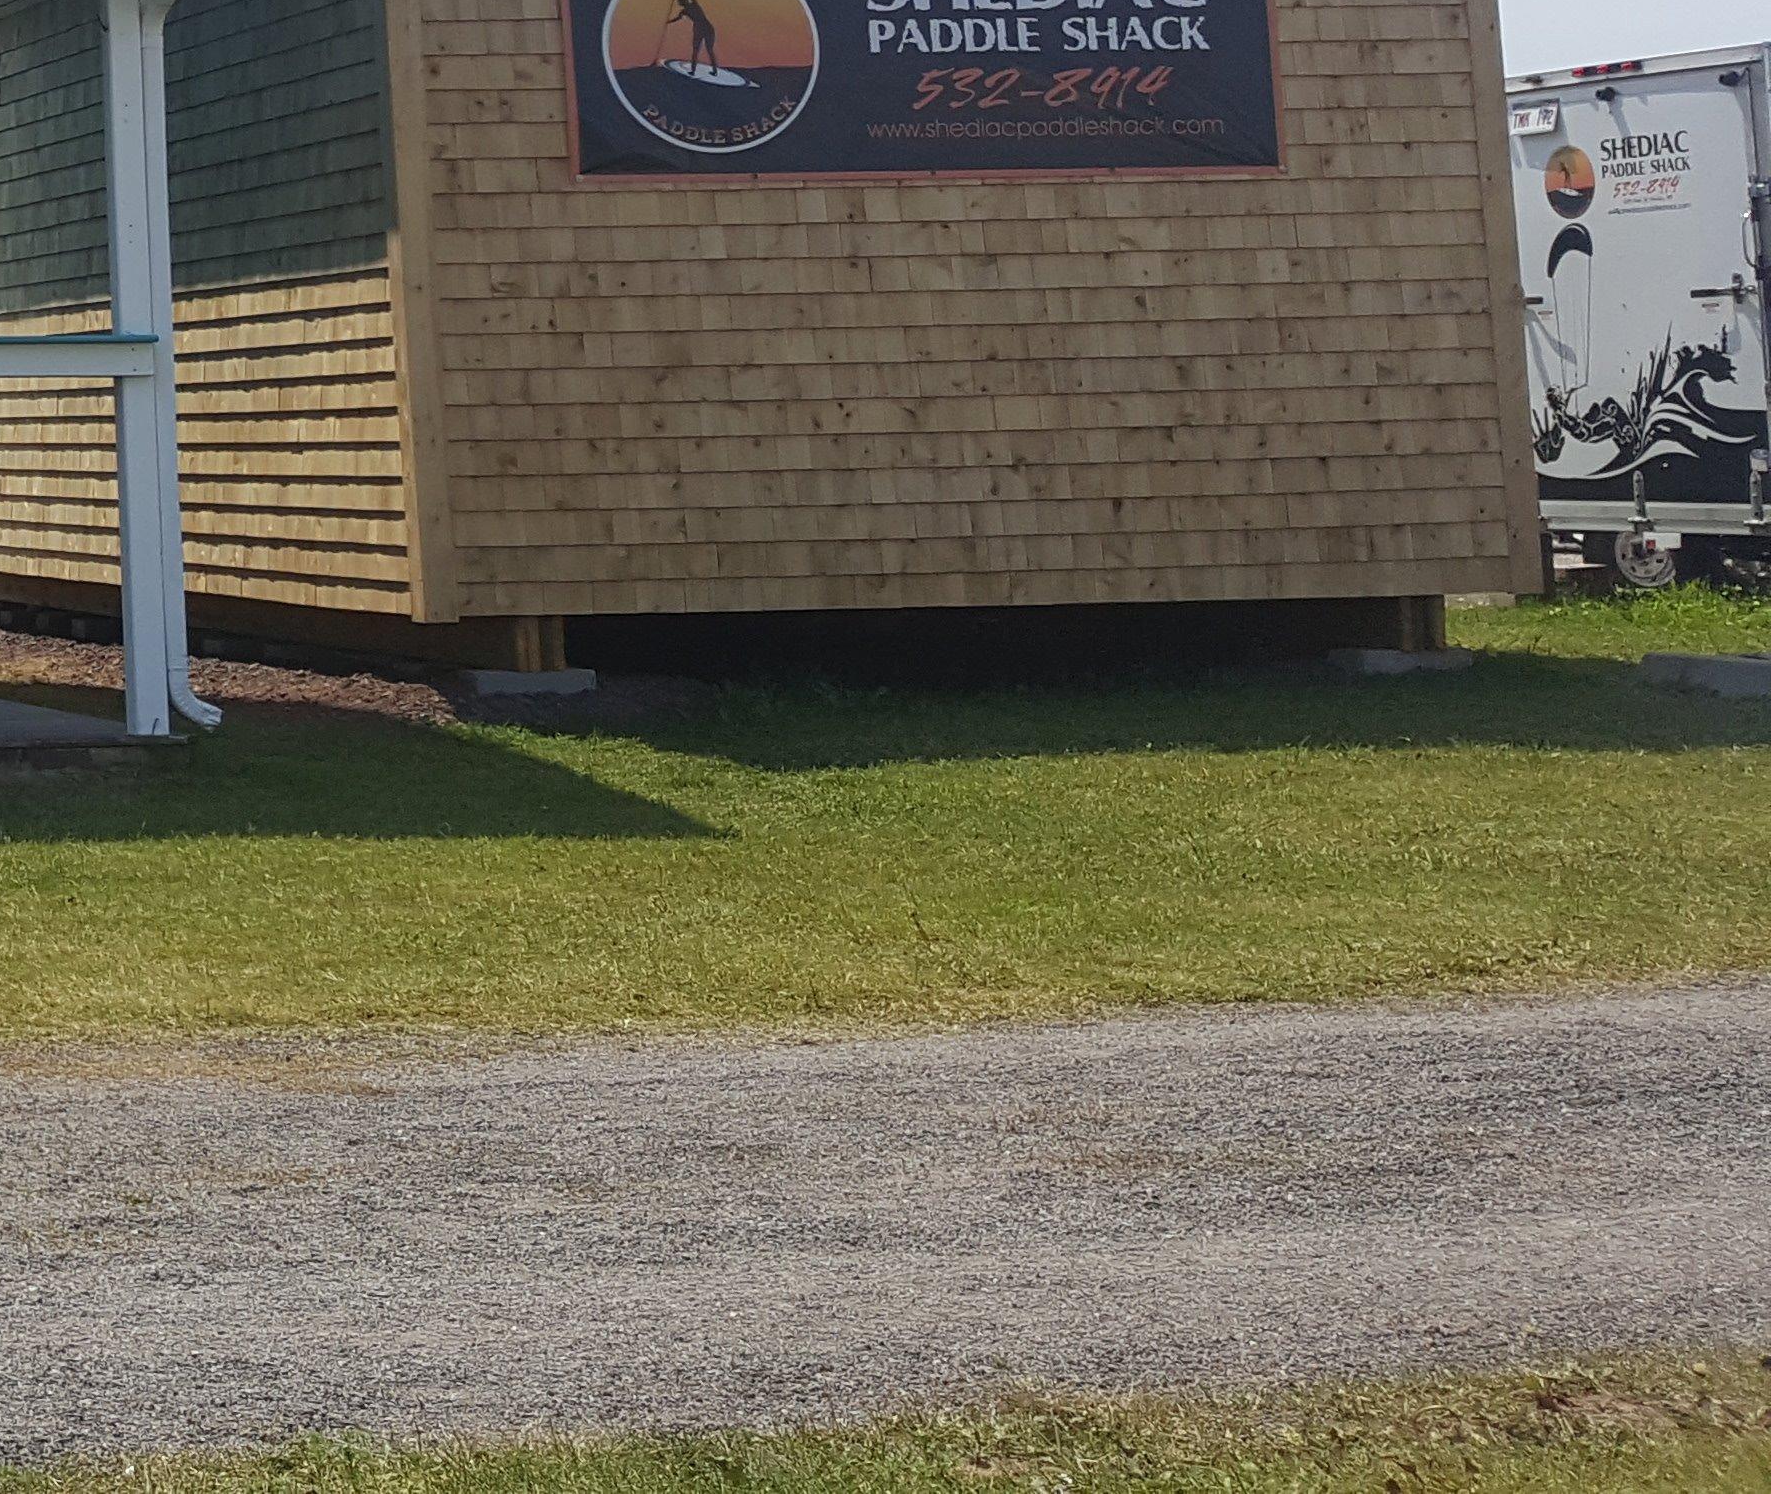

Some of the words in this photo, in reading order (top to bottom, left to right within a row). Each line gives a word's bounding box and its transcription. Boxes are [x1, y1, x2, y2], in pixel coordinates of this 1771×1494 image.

[867, 17, 1041, 54] PADDLE
[1061, 15, 1211, 52] SHACK
[912, 65, 1174, 110] 532-8914
[643, 103, 726, 144] PADDLE
[731, 95, 797, 142] SHACK
[867, 115, 1225, 140] www.shediacpaddleshack.com
[1600, 129, 1690, 162] SHEDIAC
[1601, 159, 1646, 179] PADDLE
[1649, 155, 1691, 174] SHACK
